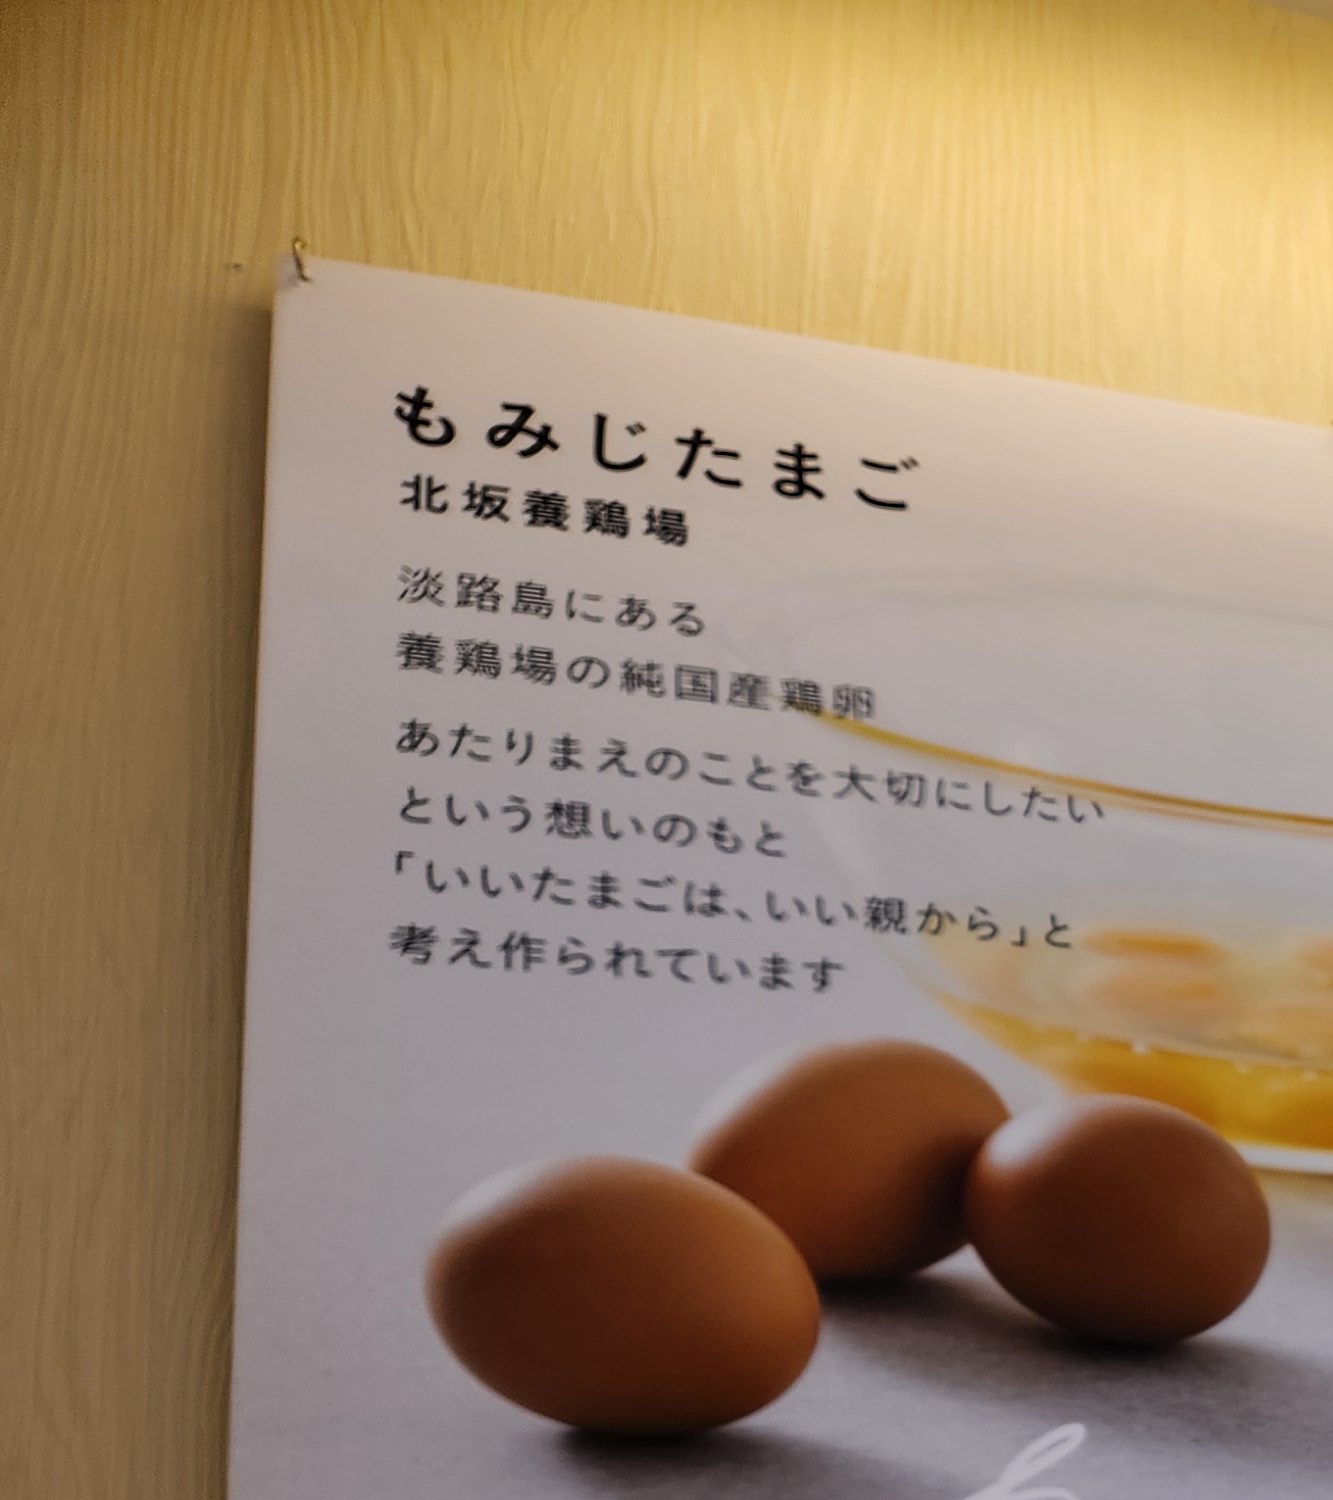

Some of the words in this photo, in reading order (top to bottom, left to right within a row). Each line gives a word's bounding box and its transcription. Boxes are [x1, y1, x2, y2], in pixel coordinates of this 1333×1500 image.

[395, 386, 923, 512] もみじたまご
[400, 476, 688, 545] 北坂養鶏場
[397, 564, 705, 637] 淡路島にある
[396, 633, 874, 719] 養鶏場の純国産鶏卵
[395, 719, 1104, 824] あたりまえのことを大切にしたい
[398, 788, 788, 857] という想いのもと
[392, 853, 1074, 947] 「いいたまごは、いい親から」と
[390, 924, 844, 992] 考え作られています
